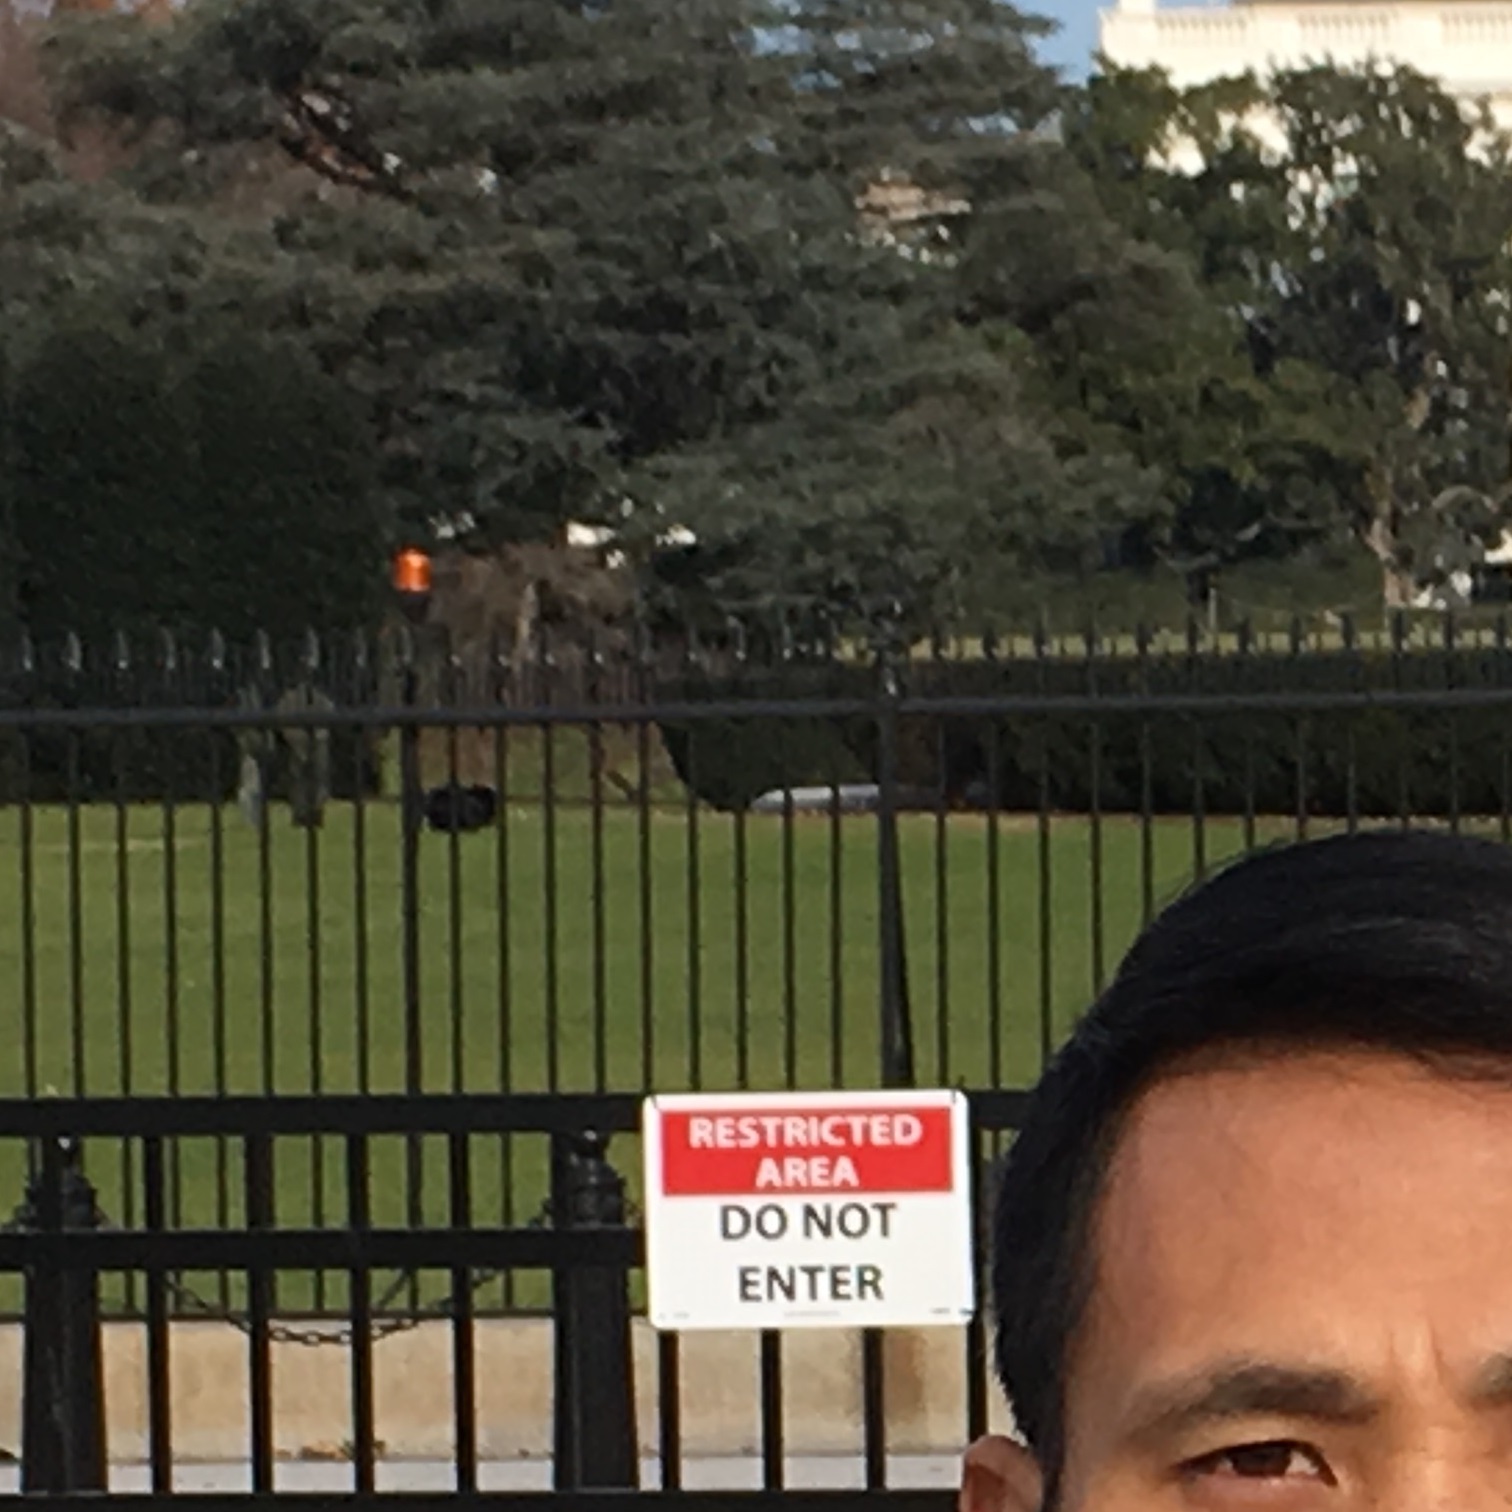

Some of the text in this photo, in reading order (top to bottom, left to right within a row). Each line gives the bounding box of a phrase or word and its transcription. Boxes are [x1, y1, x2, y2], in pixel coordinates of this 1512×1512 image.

[689, 1114, 922, 1148] RESTRICTED
[755, 1156, 859, 1187] AREA
[720, 1202, 897, 1240] DO NOT
[738, 1265, 884, 1302] ENTER
